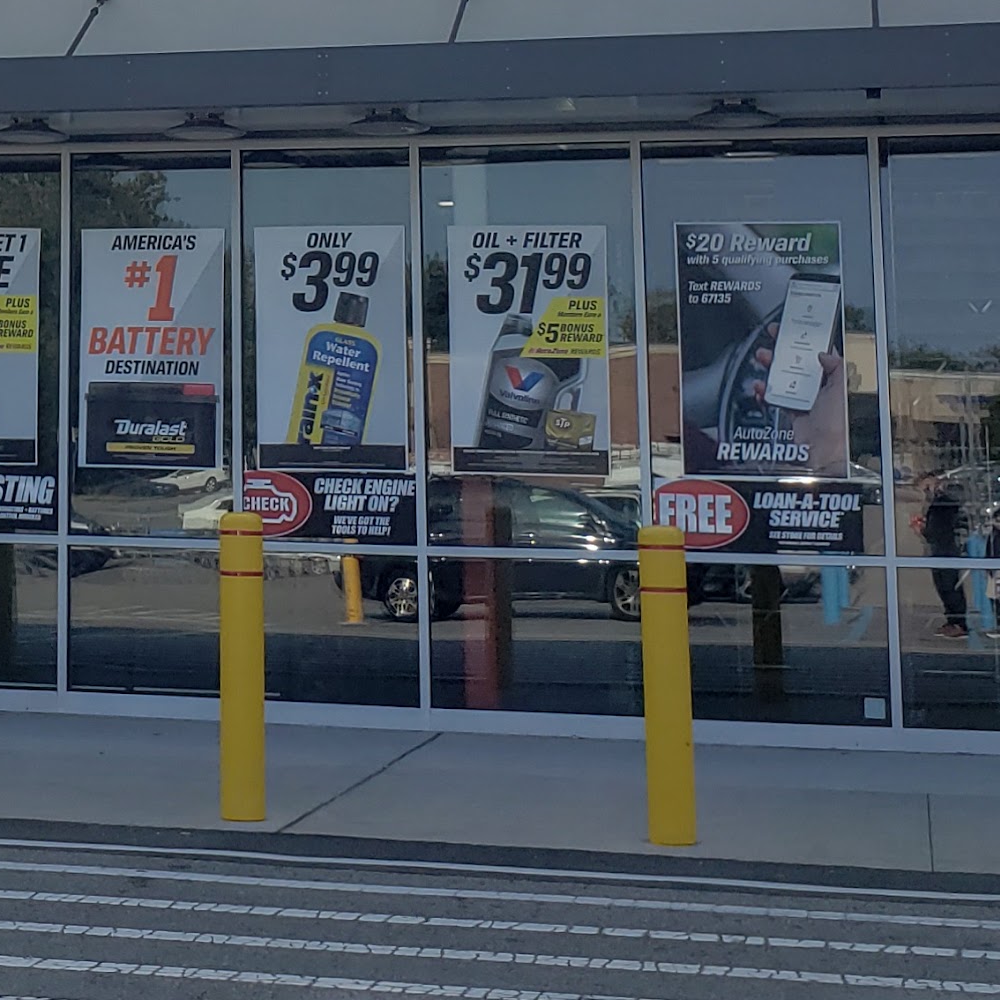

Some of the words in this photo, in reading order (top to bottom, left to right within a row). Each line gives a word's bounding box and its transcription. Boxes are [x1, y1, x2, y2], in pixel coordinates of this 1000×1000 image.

[19, 234, 28, 253] 1
[112, 234, 197, 251] AMERICA'S
[307, 232, 353, 249] ONLY
[472, 232, 500, 248] OIL
[523, 232, 582, 248] FILTER
[685, 233, 725, 252] $20
[730, 232, 812, 252] Reward
[687, 254, 710, 265] with
[712, 254, 719, 265] 5
[721, 254, 772, 267] qualifying
[775, 254, 829, 266] purchases
[124, 255, 179, 322] #1
[688, 280, 709, 292] Text
[709, 280, 762, 292] REWARDS
[5, 298, 31, 308] PLUS
[568, 300, 597, 311] PLUS
[688, 293, 699, 304] to
[701, 293, 732, 304] 67135
[537, 322, 560, 343] $5
[560, 323, 595, 333] BONUS
[88, 326, 216, 356] BATTERY
[560, 333, 603, 343] REWARD
[326, 341, 362, 359] Water
[105, 360, 200, 376] DESTINATION
[313, 350, 371, 373] Repellent
[114, 419, 187, 436] Duralast
[555, 418, 571, 429] STP
[733, 426, 795, 441] AutoZone
[717, 442, 810, 462] REWARDS
[314, 477, 363, 495] CHECK
[364, 479, 417, 497] ENGINE
[243, 496, 290, 512] CHECK
[324, 495, 367, 512] LIGHT
[367, 495, 400, 513] ON?
[753, 491, 862, 511] LOAN-A-TOOL
[333, 515, 357, 525] WE'VE
[358, 515, 374, 526] GOT
[375, 516, 391, 526] THE
[658, 493, 733, 534] FREE
[769, 510, 842, 528] SERVICE
[331, 525, 357, 535] TOOLS
[357, 526, 368, 535] TO
